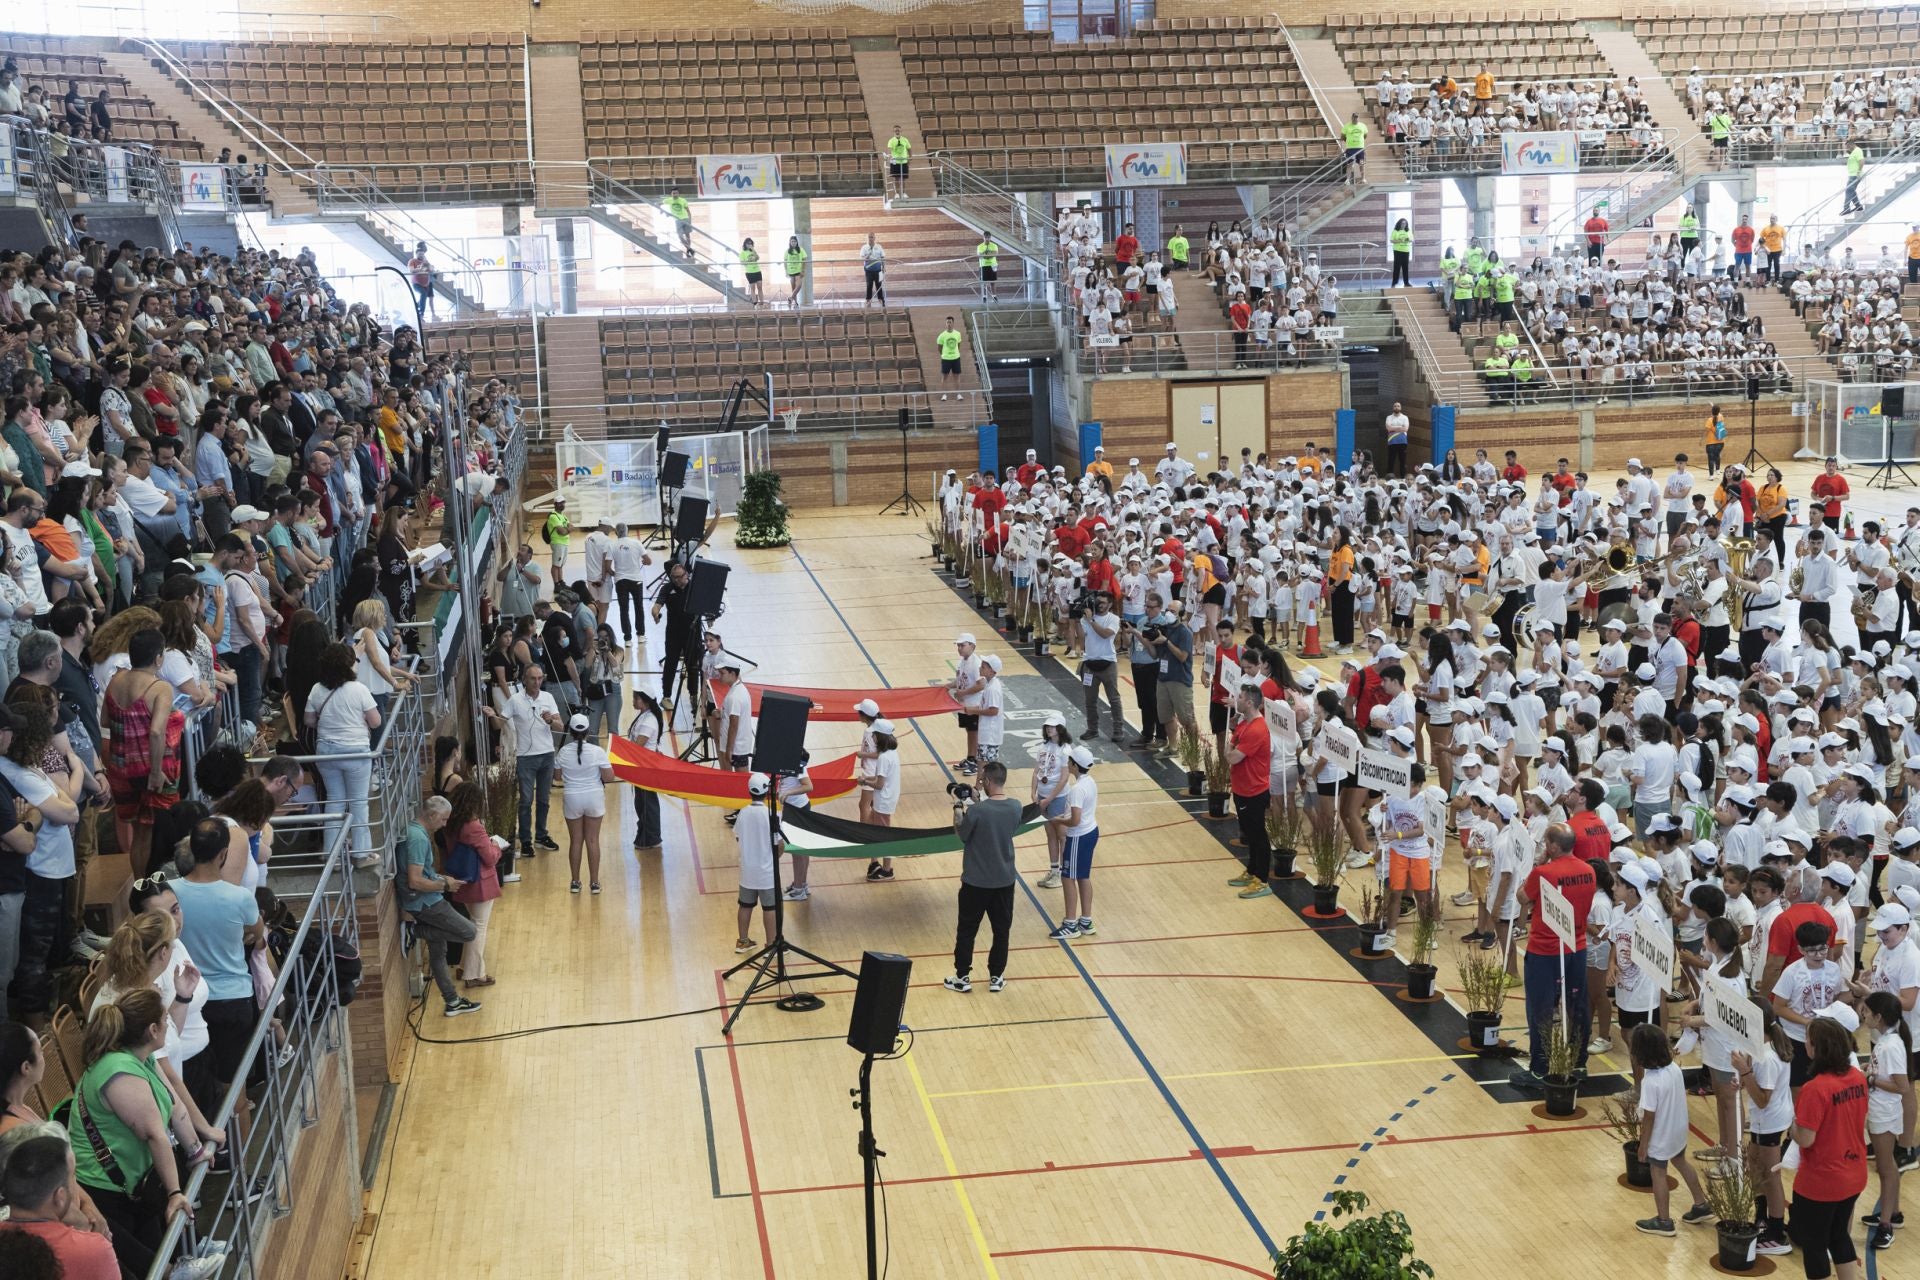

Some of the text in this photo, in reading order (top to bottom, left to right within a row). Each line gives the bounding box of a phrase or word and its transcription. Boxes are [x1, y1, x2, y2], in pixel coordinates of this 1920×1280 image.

[624, 471, 655, 482] Badajoz
[1360, 761, 1407, 787] PSICOMOTRICIDAD
[1557, 872, 1594, 887] MONITOR
[1634, 931, 1645, 953] TIRO
[1645, 941, 1656, 962] CON
[1655, 951, 1669, 976] ARCO
[1716, 998, 1749, 1039] VOLEIBOL
[1832, 1084, 1866, 1106] MONITOR
